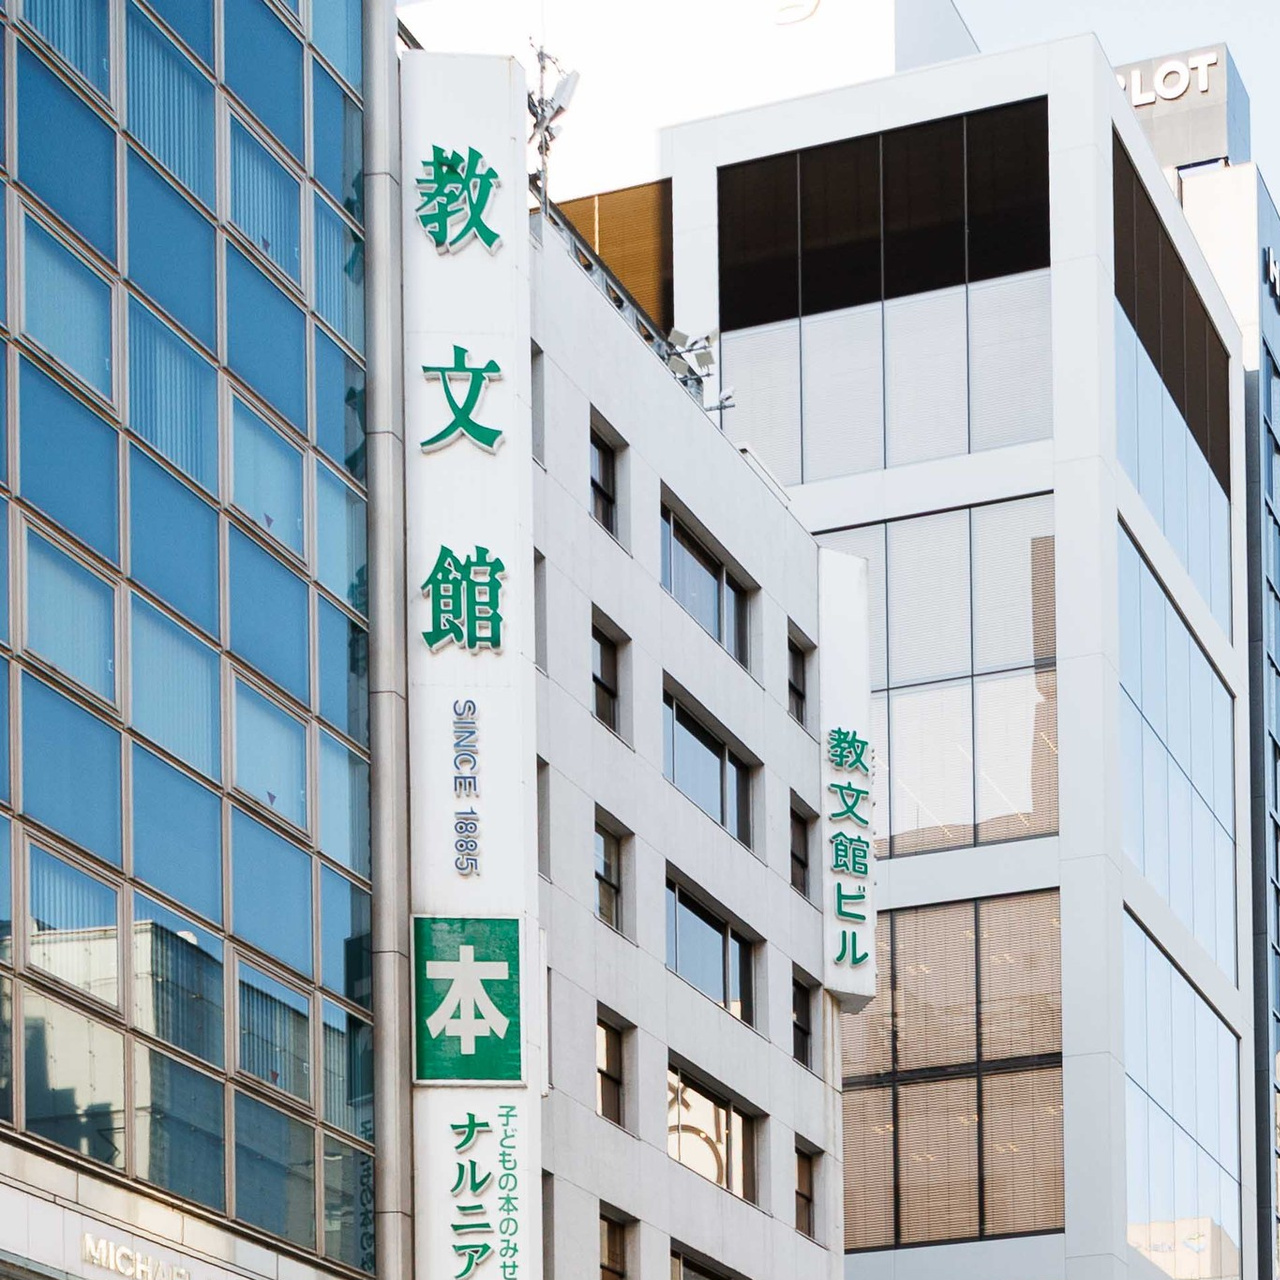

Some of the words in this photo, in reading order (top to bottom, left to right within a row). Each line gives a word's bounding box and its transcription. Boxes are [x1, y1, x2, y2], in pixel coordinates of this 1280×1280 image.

[1116, 52, 1217, 107] LOT
[415, 145, 504, 655] 教文館
[453, 700, 479, 798] SINCE
[454, 806, 479, 877] 1885
[828, 727, 869, 967] 教文館ビル
[426, 945, 510, 1055] 本
[497, 1105, 518, 1280] 子どもの本のみせ
